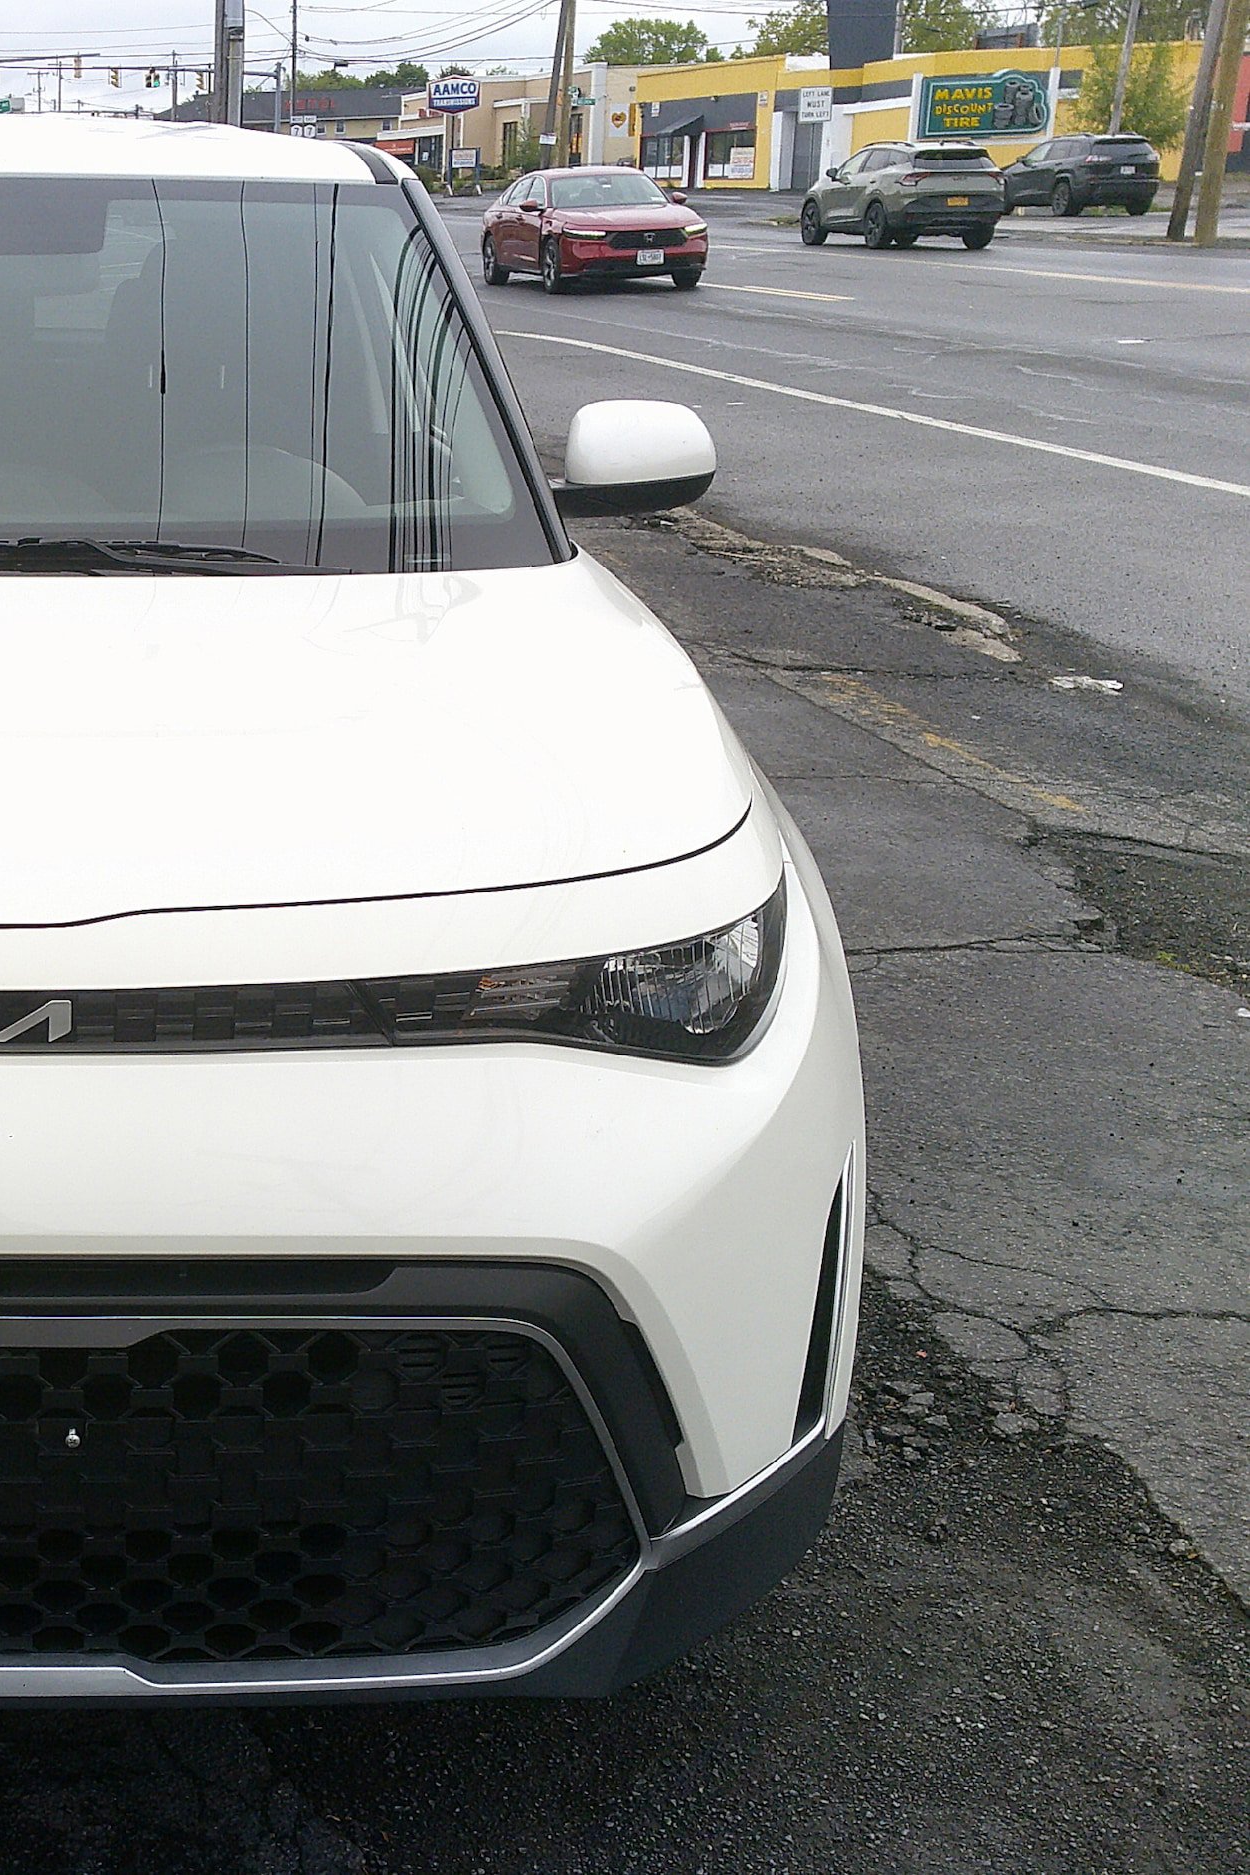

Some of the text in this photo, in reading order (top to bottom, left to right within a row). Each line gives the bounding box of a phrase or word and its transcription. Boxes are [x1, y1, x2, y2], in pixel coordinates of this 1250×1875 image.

[433, 82, 477, 96] AAMCO
[934, 87, 992, 100] MAVIS
[807, 100, 825, 108] MUST
[935, 102, 994, 115] DISCOUNT
[801, 110, 830, 119] TURN LEFT
[943, 117, 981, 128] TIRE
